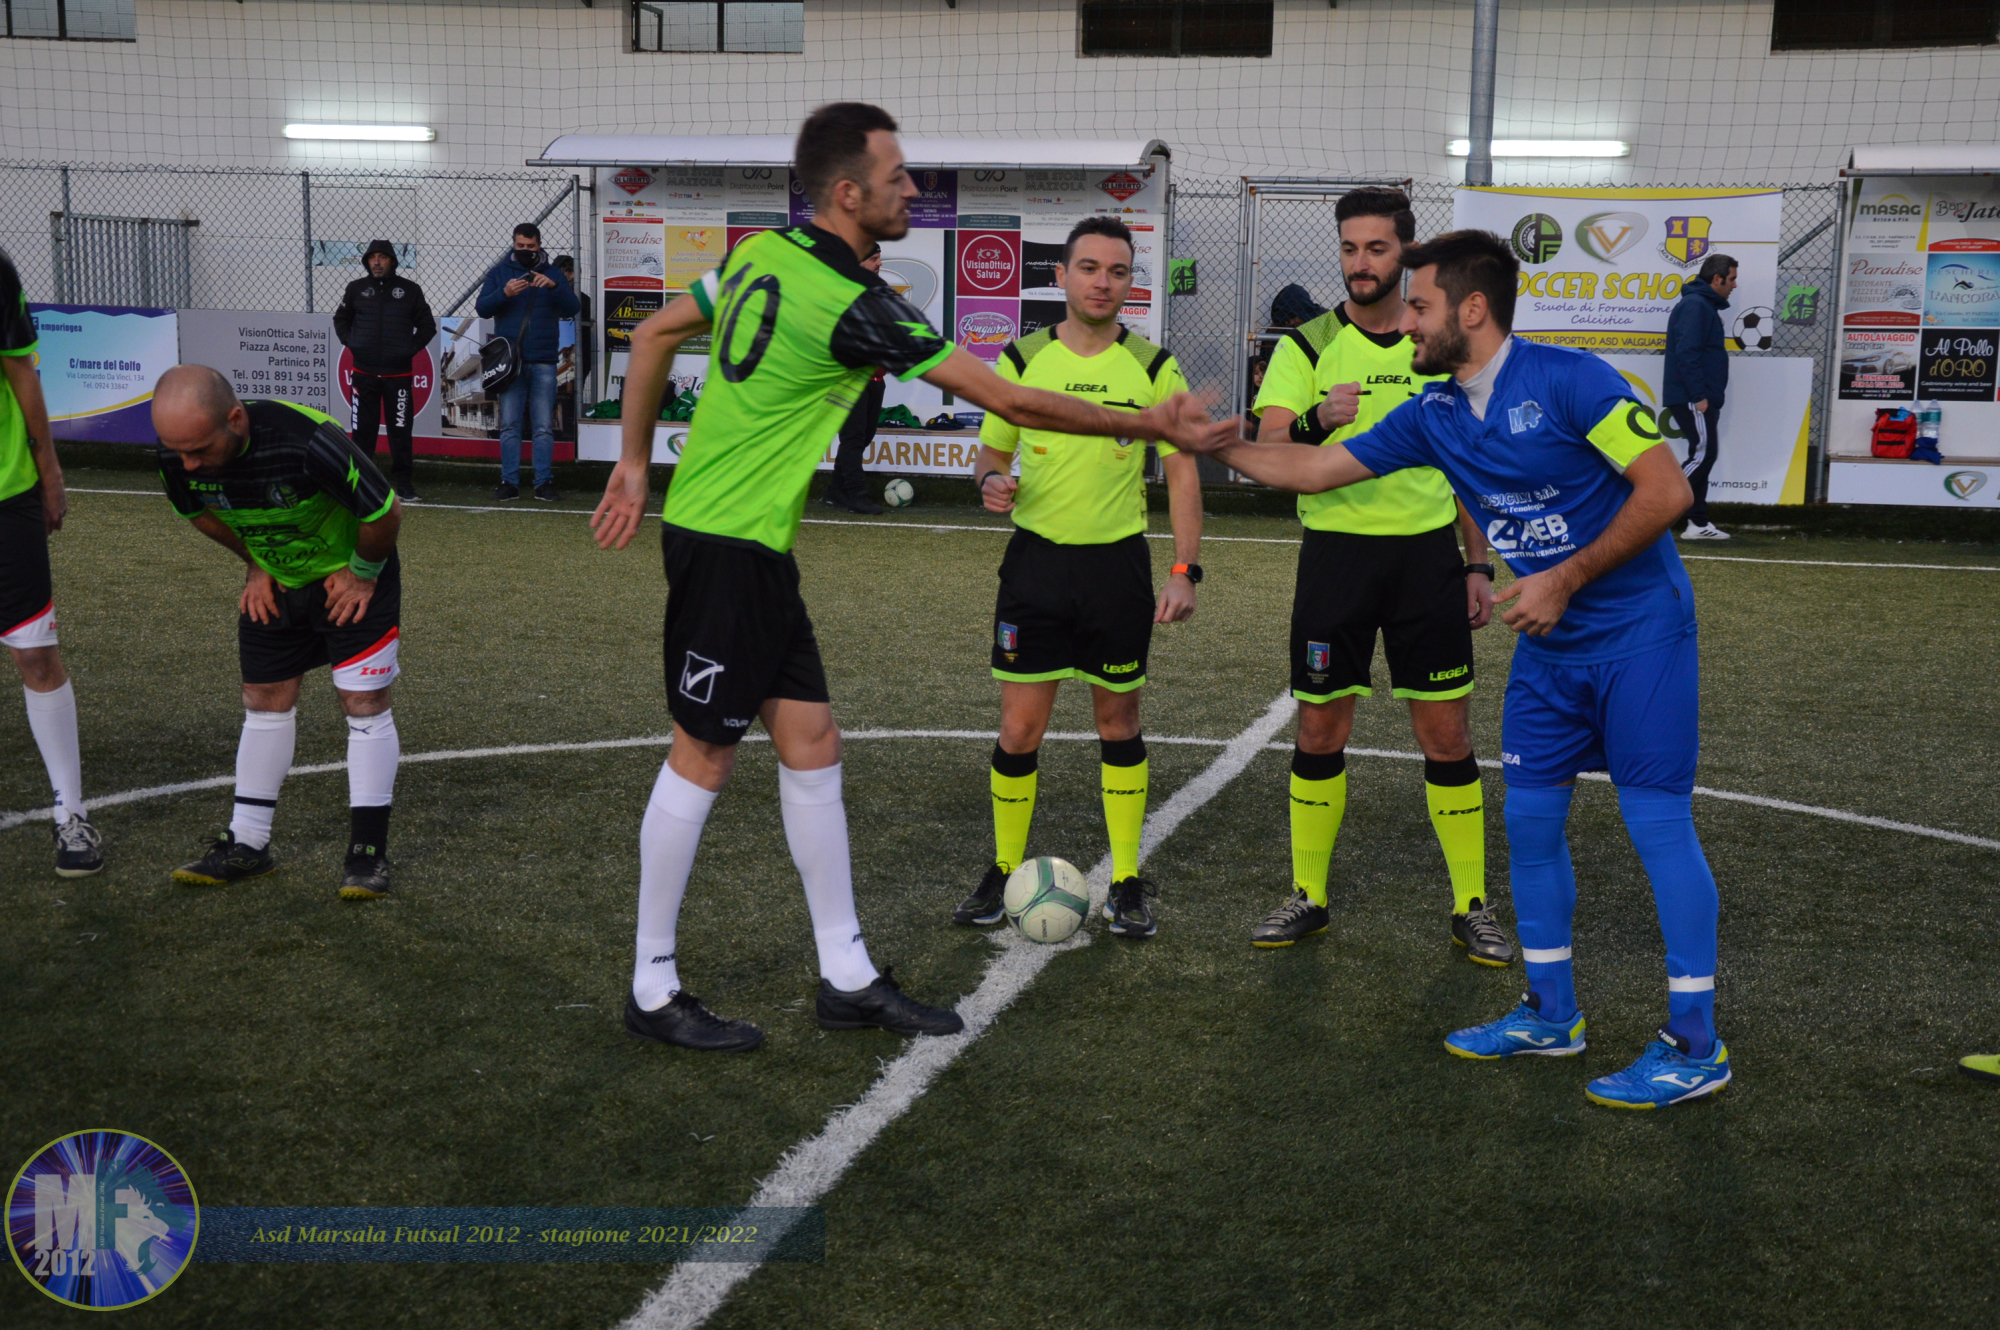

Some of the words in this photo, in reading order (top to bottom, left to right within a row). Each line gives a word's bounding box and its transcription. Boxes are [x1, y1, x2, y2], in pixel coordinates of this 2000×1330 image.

[667, 178, 723, 187] MAZZOLA
[1025, 172, 1050, 181] WEB
[1052, 172, 1086, 181] STORE
[730, 182, 766, 190] Distribution
[961, 184, 998, 192] Distribution
[1000, 184, 1018, 192] Point
[1025, 181, 1085, 191] MAZZOLA
[1936, 200, 1963, 216] Bar
[605, 229, 662, 245] Paradise
[966, 260, 1011, 270] VisionOttica
[1851, 259, 1923, 275] Paradise
[976, 270, 1001, 279] Salvia
[1930, 268, 1998, 276] PESCHERIA
[1516, 272, 1598, 299] OCCER
[1603, 273, 1698, 299] SCHO
[1119, 306, 1148, 315] VAGGIO
[1534, 302, 1577, 312] Scuola
[1579, 303, 1594, 312] di
[1598, 303, 1671, 314] Formazione
[718, 262, 781, 383] 10
[1571, 315, 1633, 325] Calcistica
[41, 323, 82, 332] emporiogea
[962, 316, 1013, 338] Bongiorno
[239, 327, 295, 338] VisionOttica
[298, 329, 326, 340] Salvia
[1847, 333, 1915, 342] AUTOLAVAGGIO
[239, 341, 269, 351] Piazza
[272, 343, 309, 354] Ascone,
[313, 344, 326, 353] 23
[1553, 336, 1597, 346] SPORTIVO
[1599, 337, 1618, 346] ASD
[1621, 337, 1667, 347] VALGUARN
[1846, 342, 1868, 350] Beauty
[1925, 338, 1950, 356] Al
[1953, 338, 1993, 356] Pollo
[69, 358, 102, 370] C/mare
[103, 360, 117, 371] del
[118, 360, 141, 371] Golfo
[268, 356, 310, 367] Partinico
[313, 358, 326, 367] PA
[77, 372, 105, 380] Leonardo
[232, 369, 249, 379] Tel.
[251, 370, 270, 380] 091
[274, 371, 292, 381] 891
[297, 372, 309, 382] 94
[313, 372, 326, 382] 55
[1366, 375, 1412, 386] LEGEA
[251, 384, 270, 394] 338
[274, 385, 287, 395] 98
[290, 386, 303, 395] 37
[308, 386, 326, 396] 203
[1065, 383, 1108, 393] LEGEA
[1422, 392, 1454, 406] LEGE
[395, 388, 407, 428] MAGIC
[820, 441, 979, 467] LUARNERA
[1521, 514, 1568, 542] AEB
[1520, 534, 1569, 549] group
[1500, 551, 1525, 559] ODOTTI
[1536, 543, 1576, 558] L'ENOLOGIA
[360, 665, 392, 676] Zeus
[1103, 660, 1139, 674] LEGEA
[1429, 664, 1468, 681] LEGEA
[1502, 754, 1520, 766] GEA
